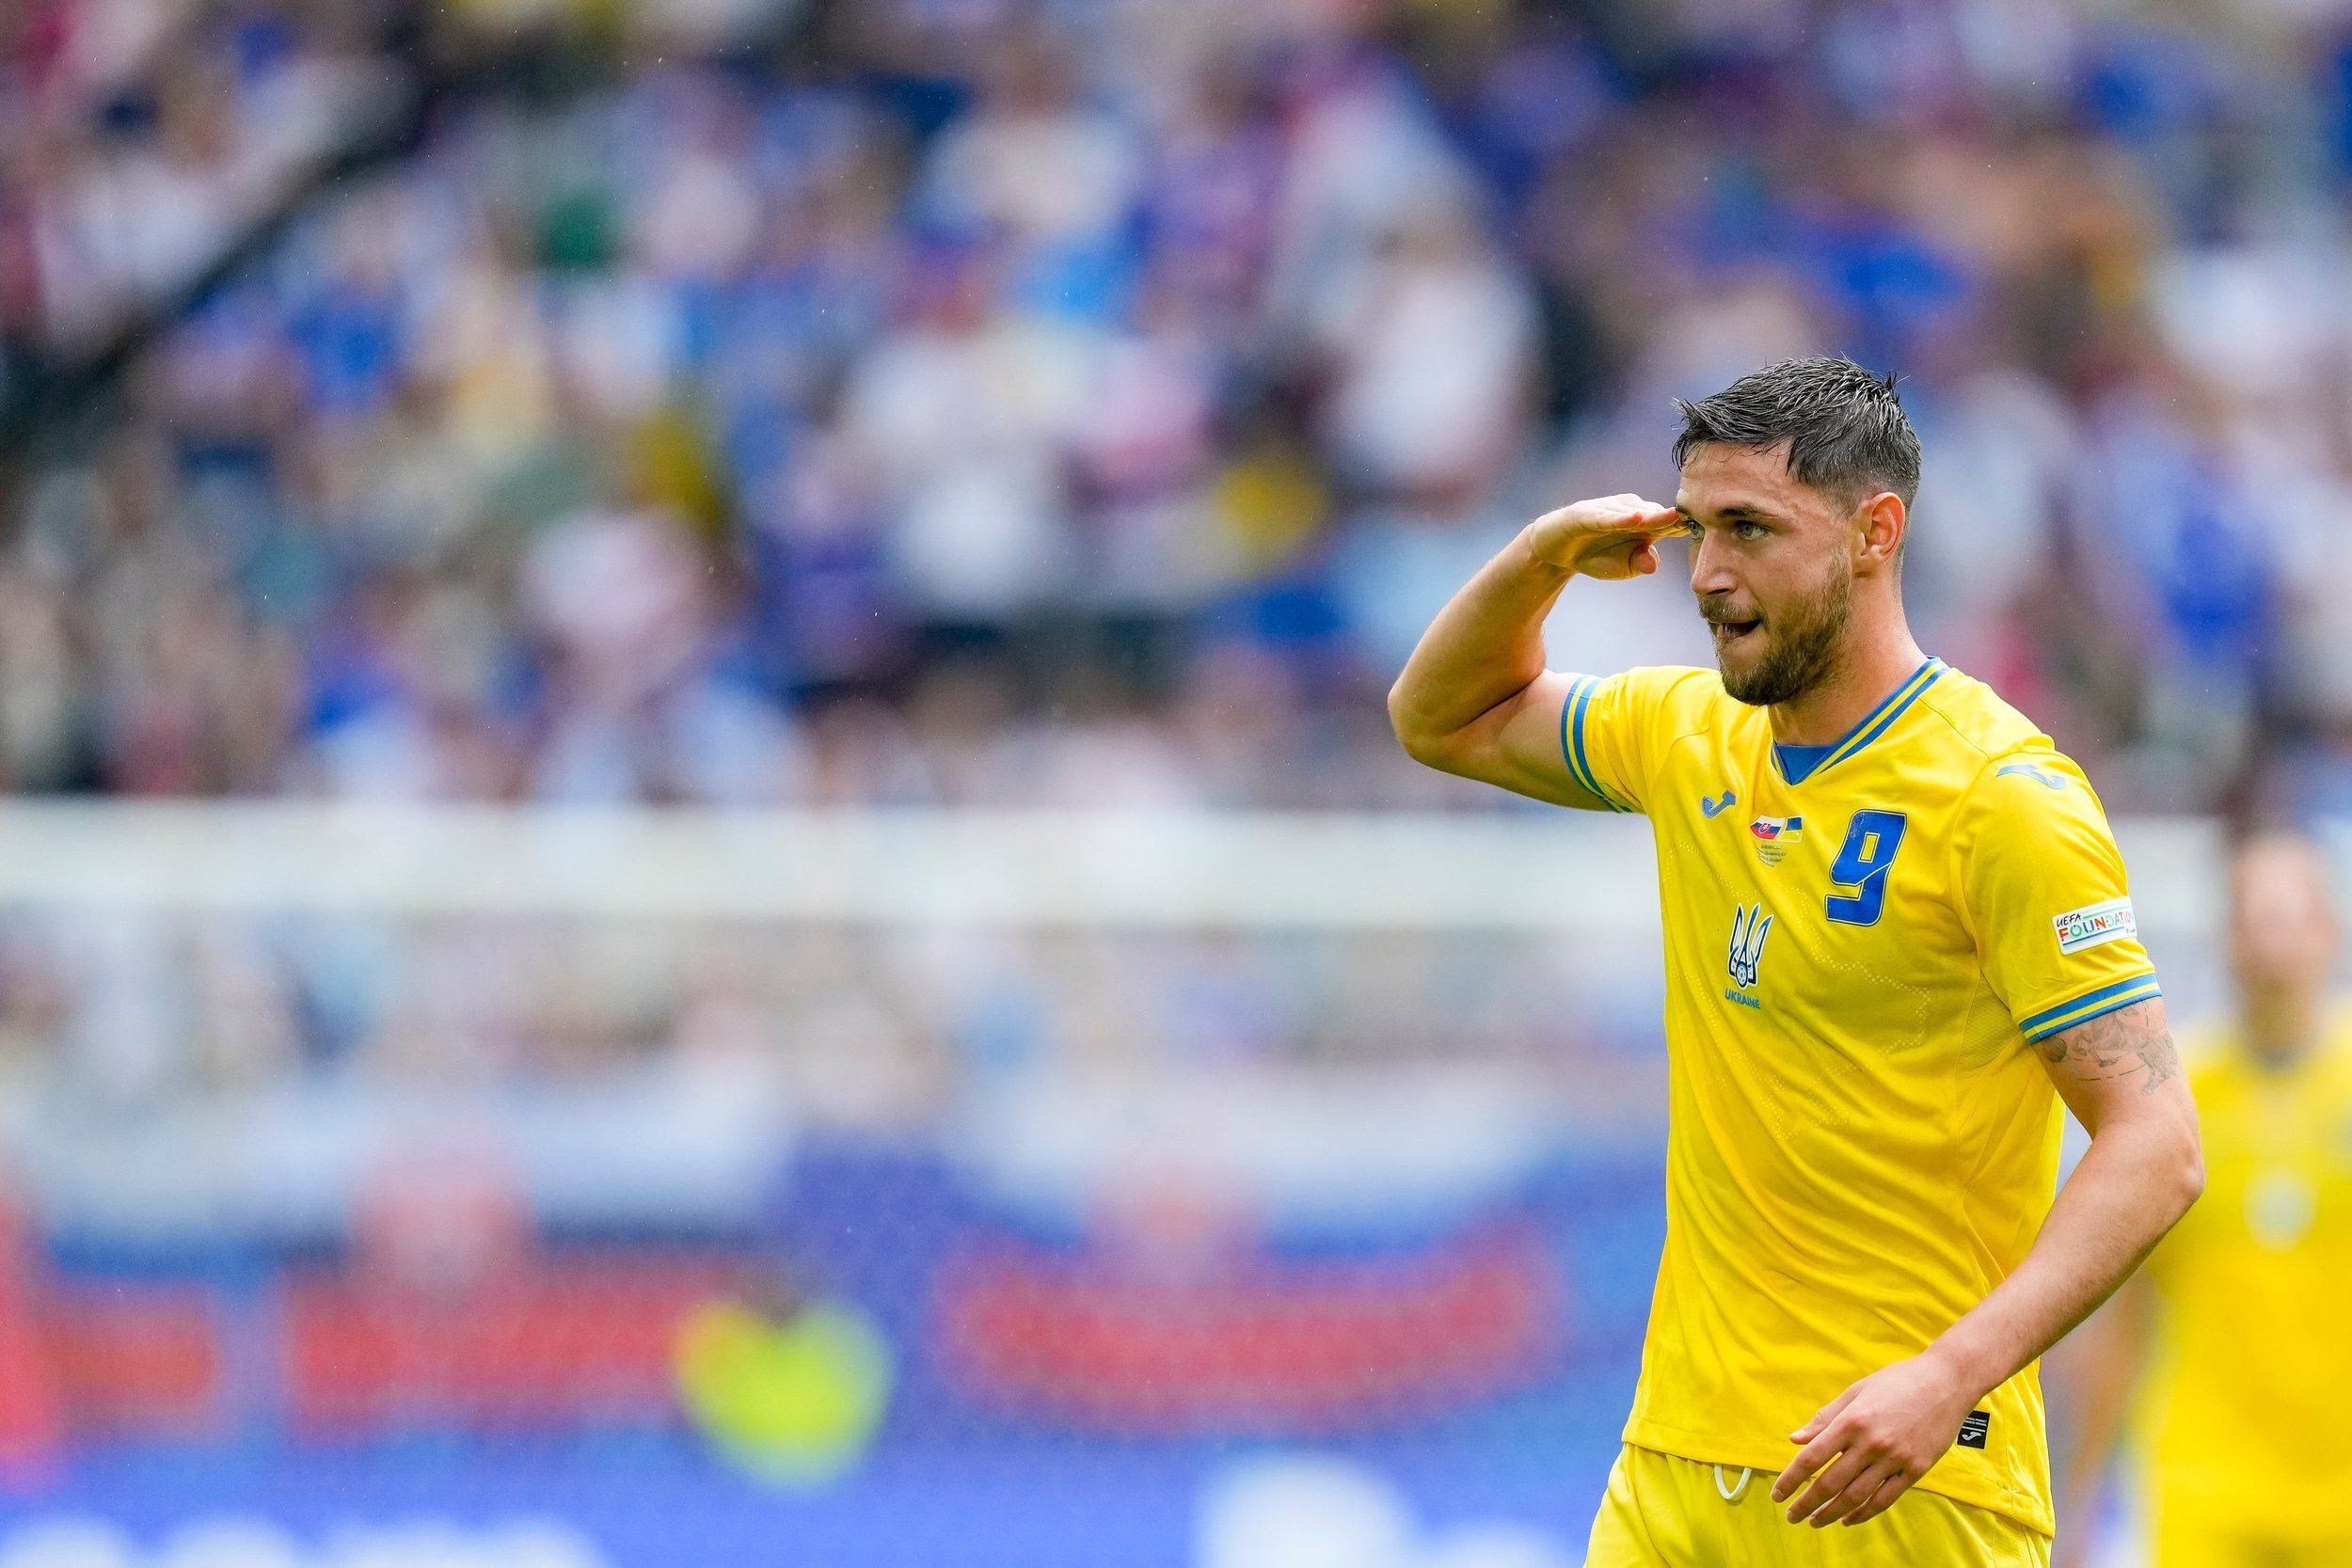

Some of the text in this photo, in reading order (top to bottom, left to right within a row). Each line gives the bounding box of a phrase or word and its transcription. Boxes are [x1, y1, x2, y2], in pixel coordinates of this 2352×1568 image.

[1823, 808, 1907, 927] 9
[2056, 912, 2082, 927] UEFA
[1724, 988, 1761, 1009] UKRAINE
